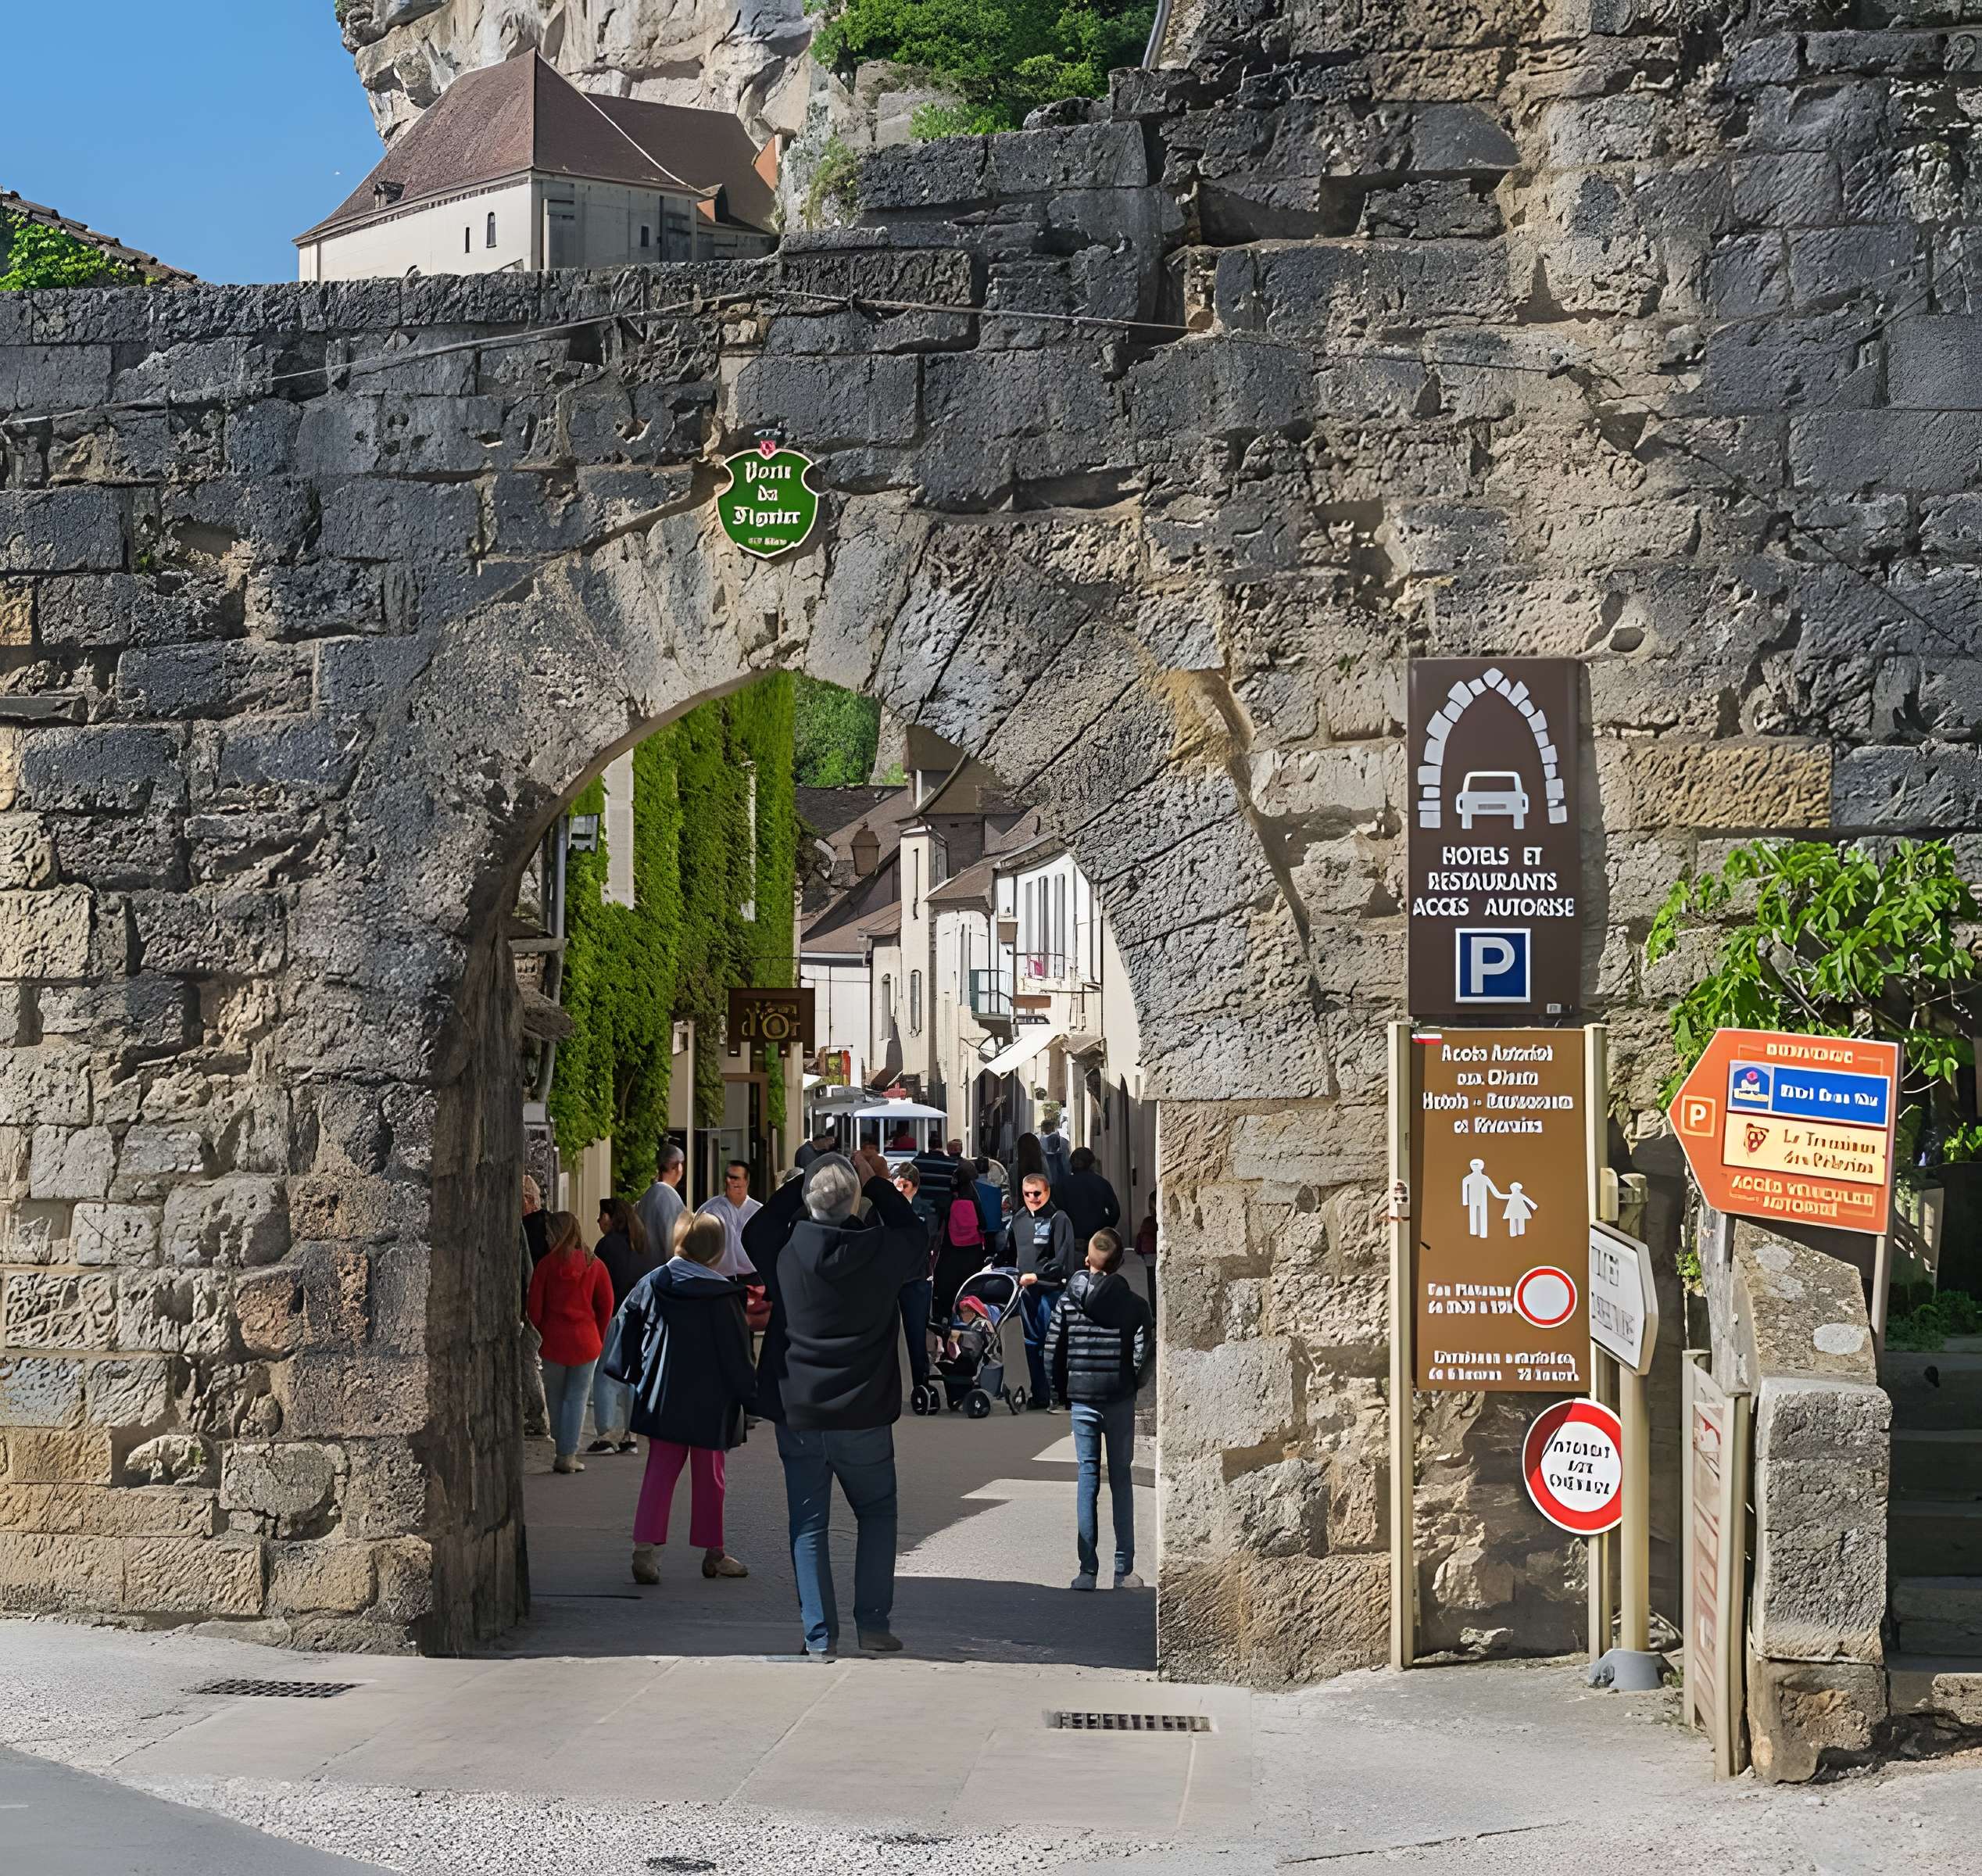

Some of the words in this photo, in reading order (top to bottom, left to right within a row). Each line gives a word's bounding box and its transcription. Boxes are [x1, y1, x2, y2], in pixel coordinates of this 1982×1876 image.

[1443, 846, 1509, 865] HOTELS
[1524, 847, 1543, 865] ET
[1428, 872, 1557, 891] RESTAURANTS
[1471, 936, 1515, 993] P
[1690, 1104, 1707, 1127] P
